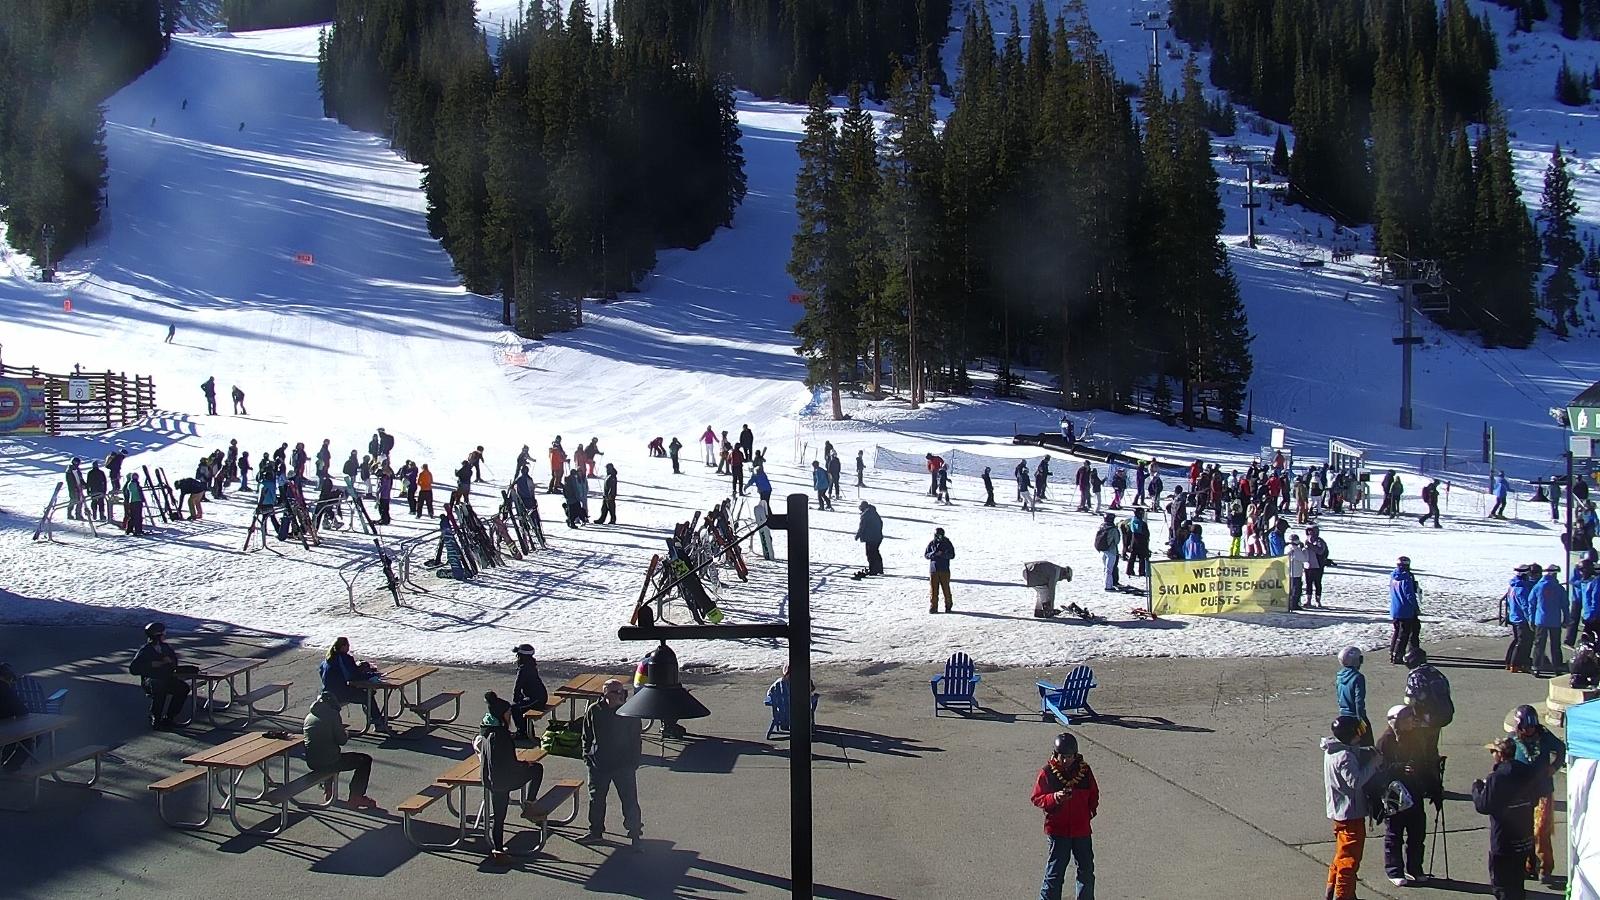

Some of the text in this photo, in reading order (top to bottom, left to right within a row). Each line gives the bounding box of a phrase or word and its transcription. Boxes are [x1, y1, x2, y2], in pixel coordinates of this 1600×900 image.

[1192, 565, 1249, 579] WELCOME
[1158, 579, 1283, 596] SKI AND RDE SCHOOL
